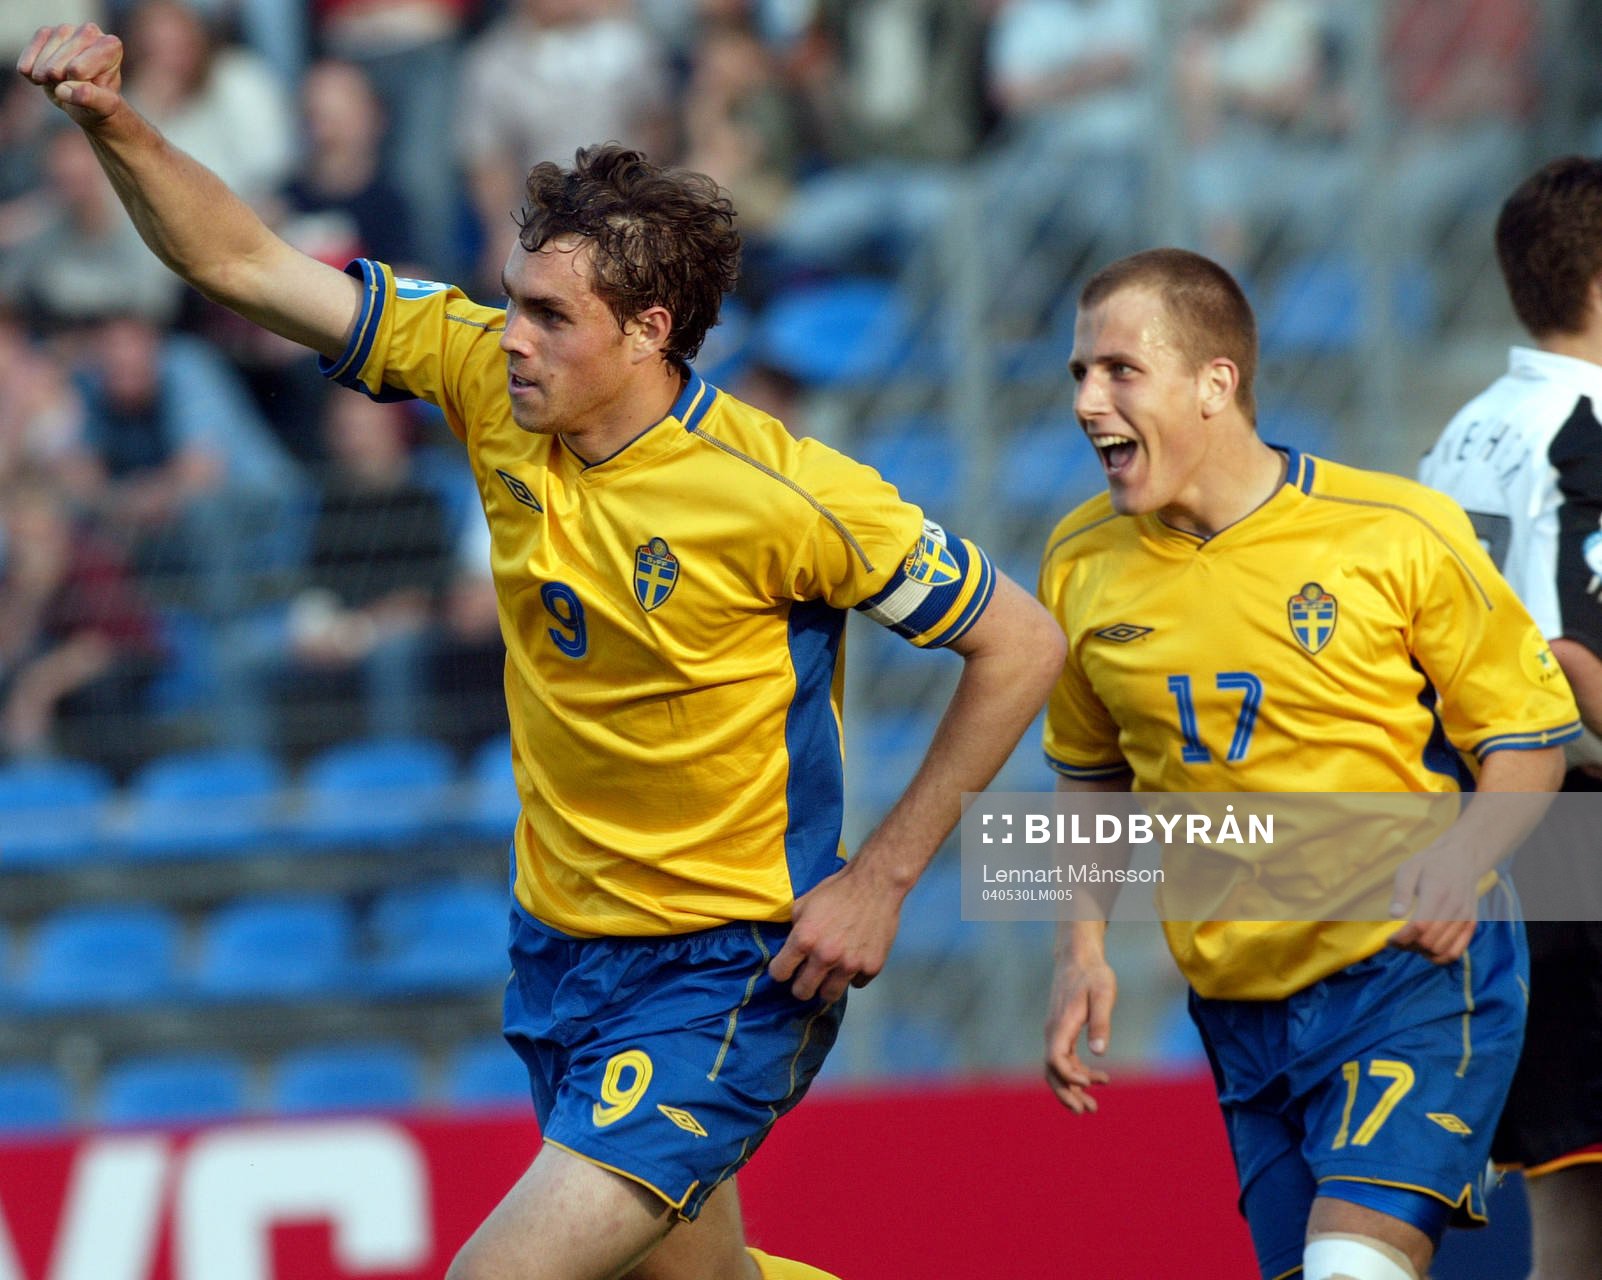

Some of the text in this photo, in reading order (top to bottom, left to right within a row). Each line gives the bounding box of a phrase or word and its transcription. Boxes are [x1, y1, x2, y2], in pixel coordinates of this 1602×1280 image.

[540, 581, 588, 659] 9
[1167, 671, 1263, 763] 17
[592, 1049, 654, 1128] 9
[1331, 1059, 1415, 1150] 17
